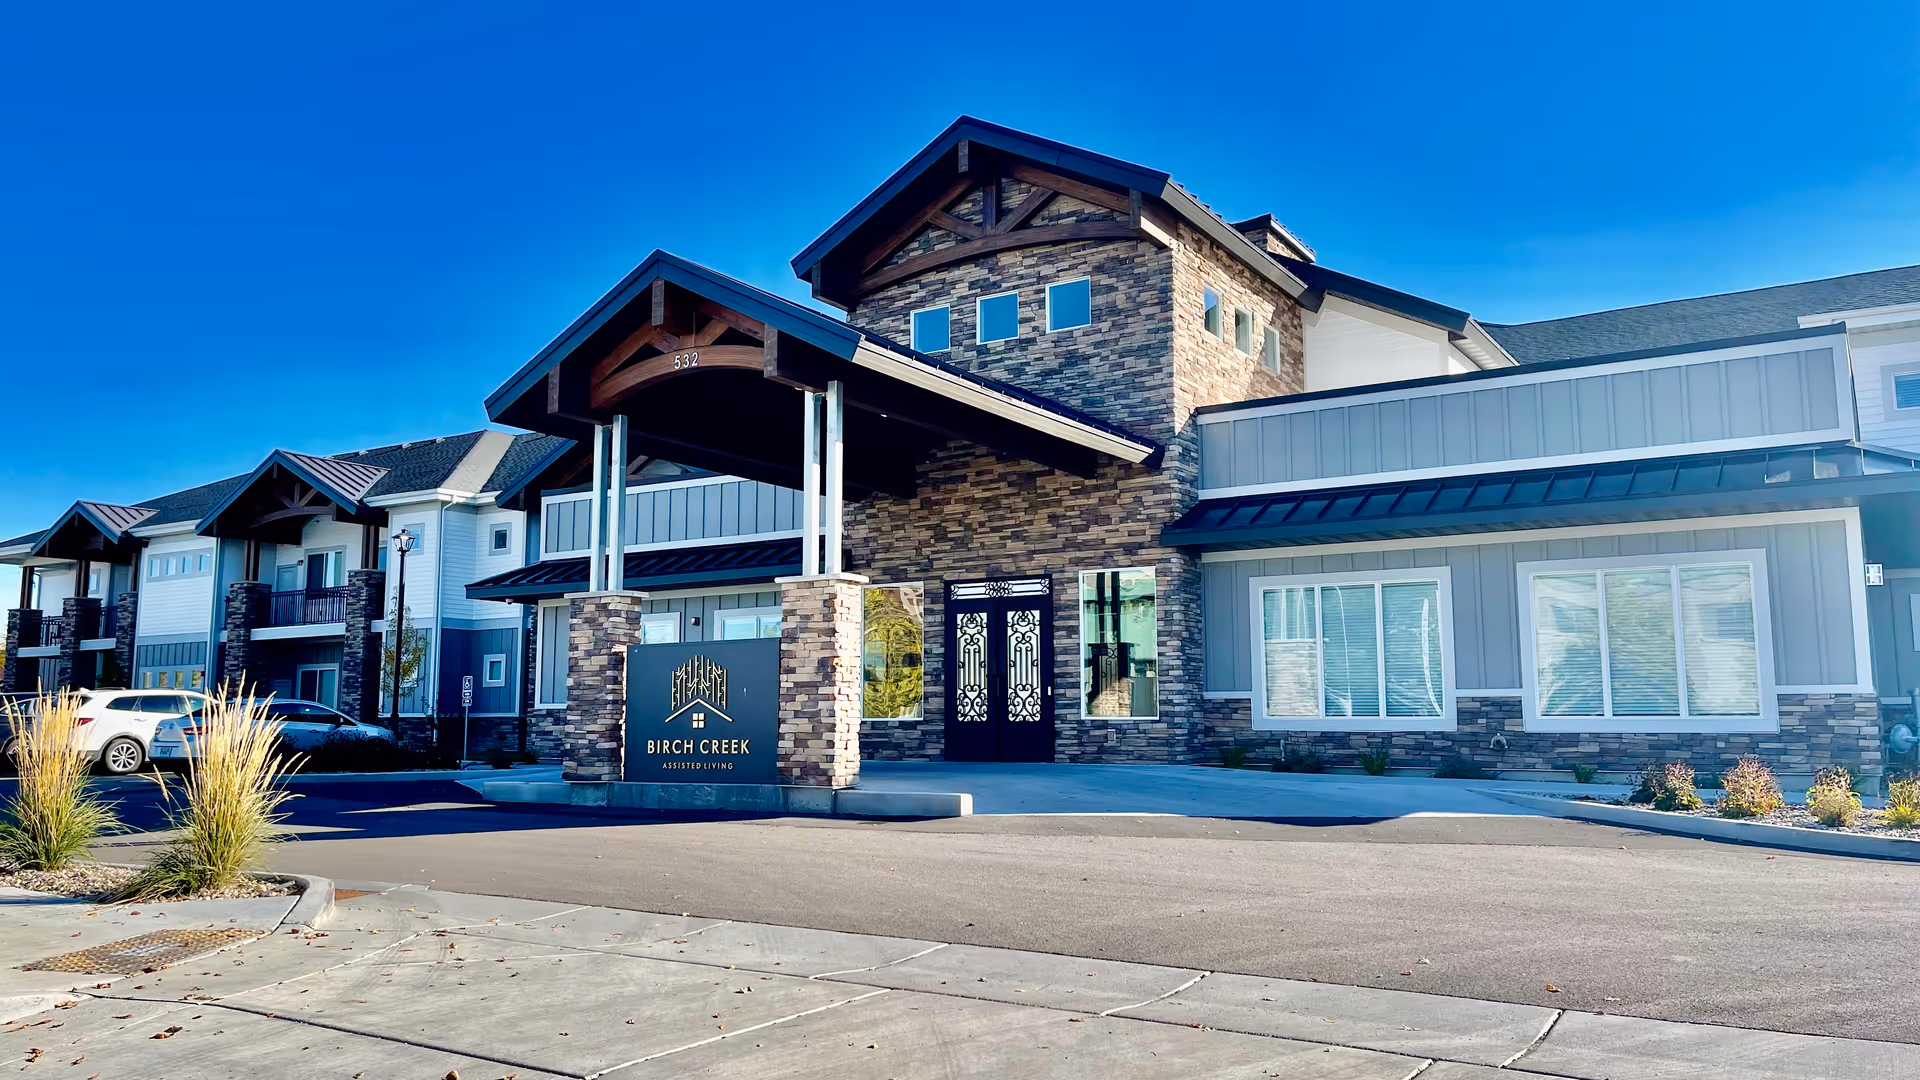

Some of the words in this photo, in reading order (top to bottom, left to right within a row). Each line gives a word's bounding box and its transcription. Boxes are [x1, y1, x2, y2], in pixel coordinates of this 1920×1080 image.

[674, 352, 698, 369] 532
[647, 739, 694, 754] BIRCH
[700, 739, 750, 754] CREEK
[663, 762, 701, 770] ASSISTED
[703, 762, 733, 770] LIVING
